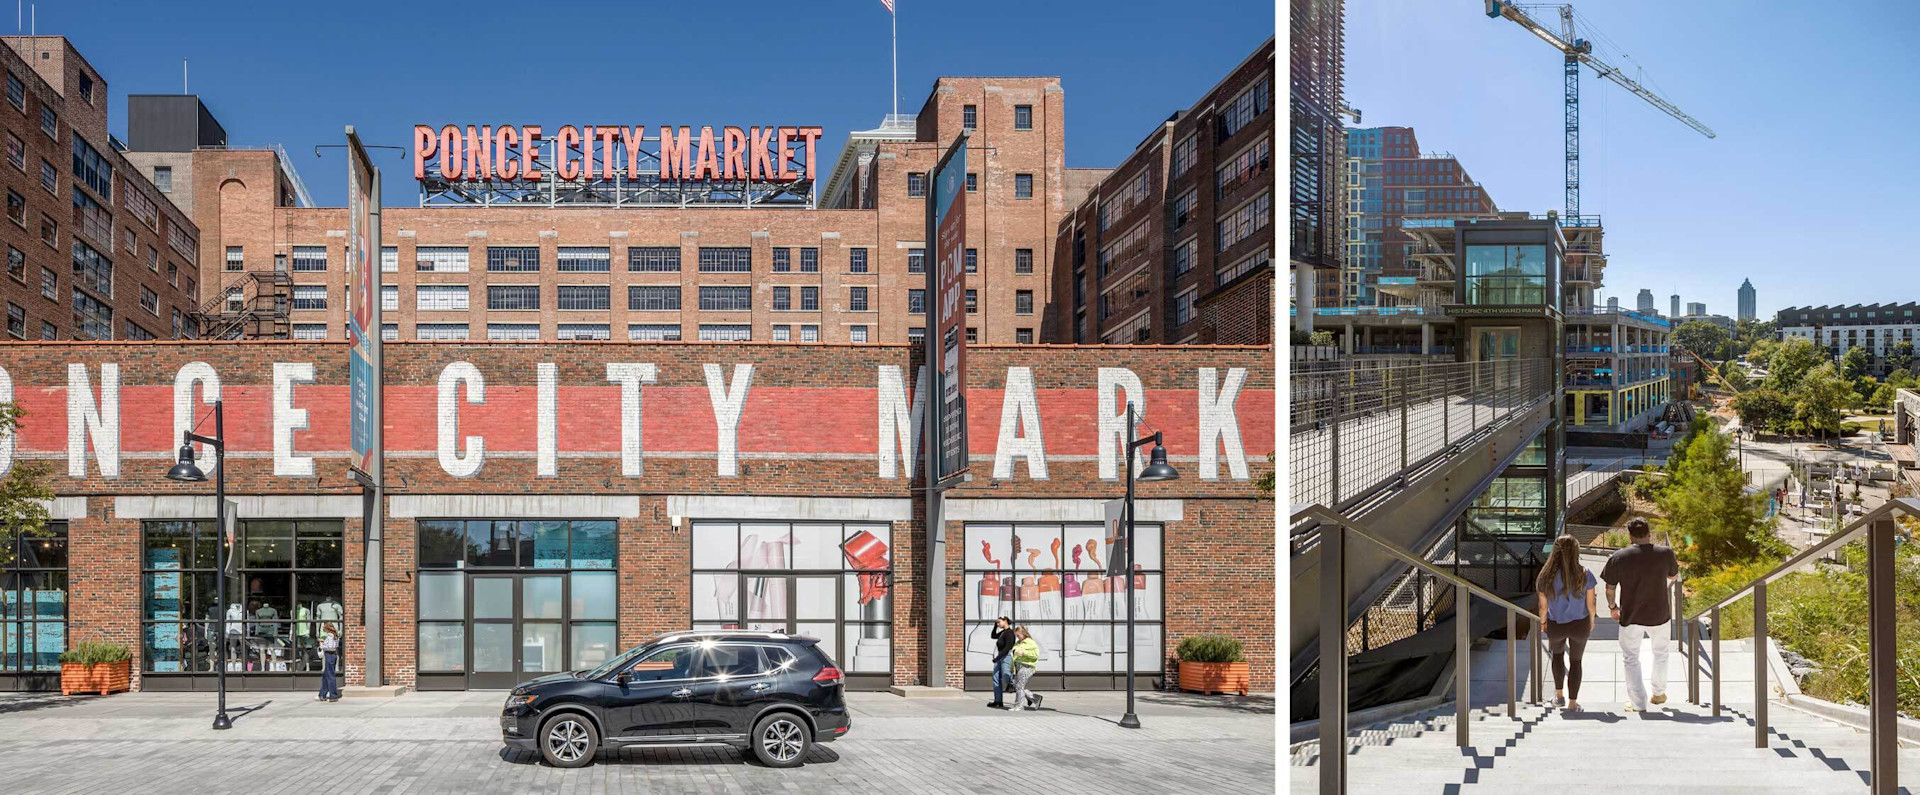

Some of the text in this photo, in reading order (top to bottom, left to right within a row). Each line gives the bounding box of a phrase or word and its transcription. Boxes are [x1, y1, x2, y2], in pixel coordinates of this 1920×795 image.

[414, 124, 823, 183] PONCE CITY MARKET
[940, 242, 963, 290] PCM
[941, 281, 961, 323] APP
[437, 360, 755, 478] CITY
